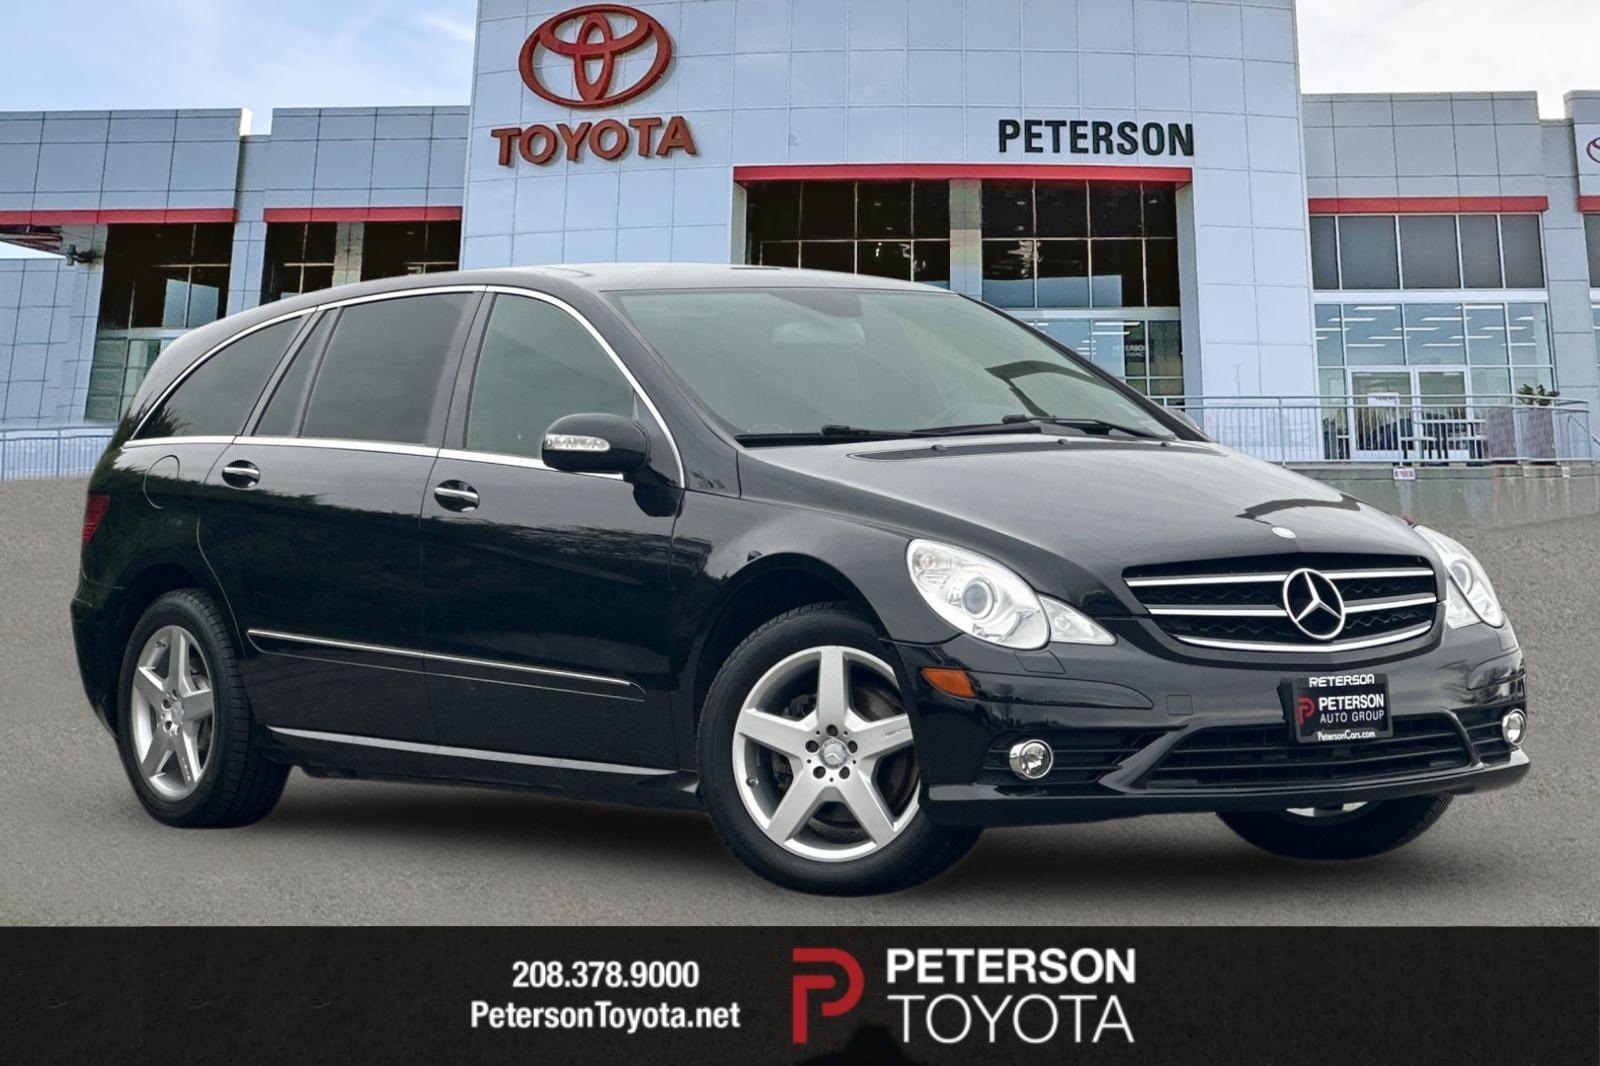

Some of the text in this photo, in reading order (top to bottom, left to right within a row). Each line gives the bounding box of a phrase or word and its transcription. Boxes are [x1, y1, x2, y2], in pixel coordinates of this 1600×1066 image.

[491, 116, 697, 166] TOYOTA
[998, 119, 1194, 157] PETERSON
[1318, 694, 1385, 711] PETERSON
[1320, 709, 1385, 724] AUTO GROUP
[1317, 729, 1376, 741] PetersonCars.com
